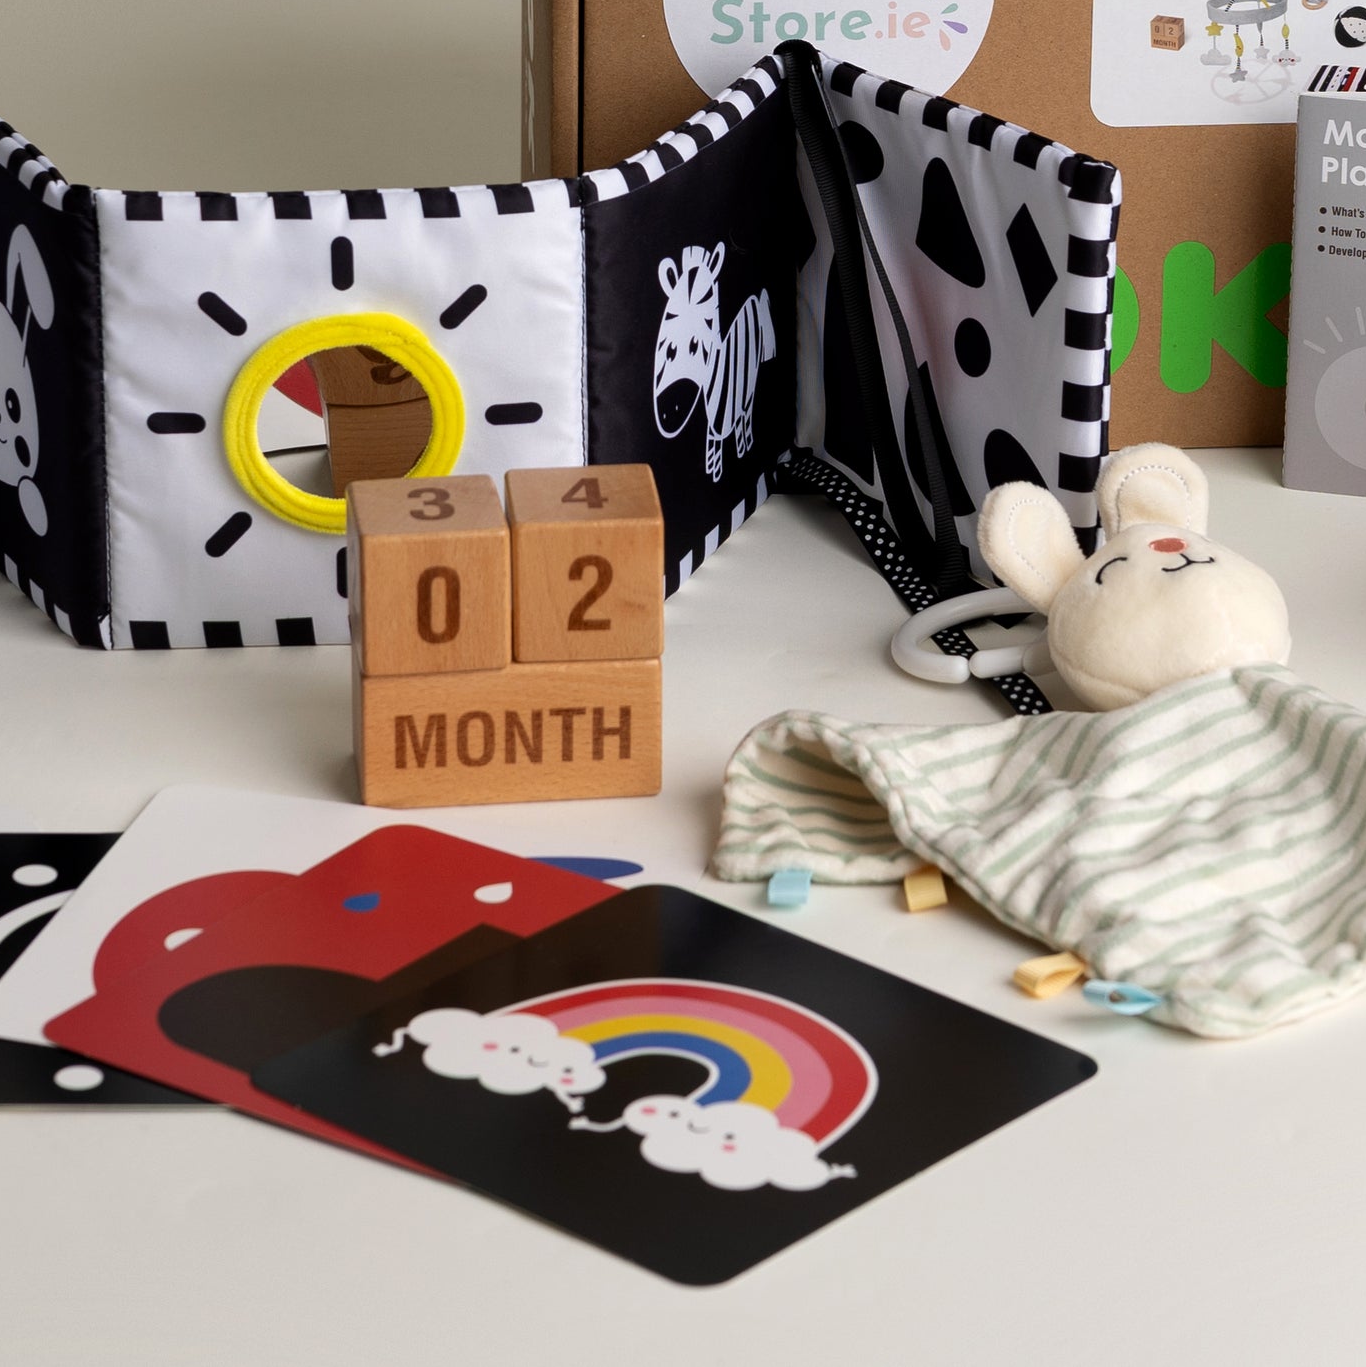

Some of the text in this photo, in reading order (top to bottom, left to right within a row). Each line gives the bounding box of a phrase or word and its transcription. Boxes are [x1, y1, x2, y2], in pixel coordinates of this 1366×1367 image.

[1331, 226, 1352, 238] How
[1355, 228, 1366, 239] To
[406, 477, 609, 521] 3 4
[415, 554, 614, 645] 0 2
[393, 704, 633, 770] MONTH
